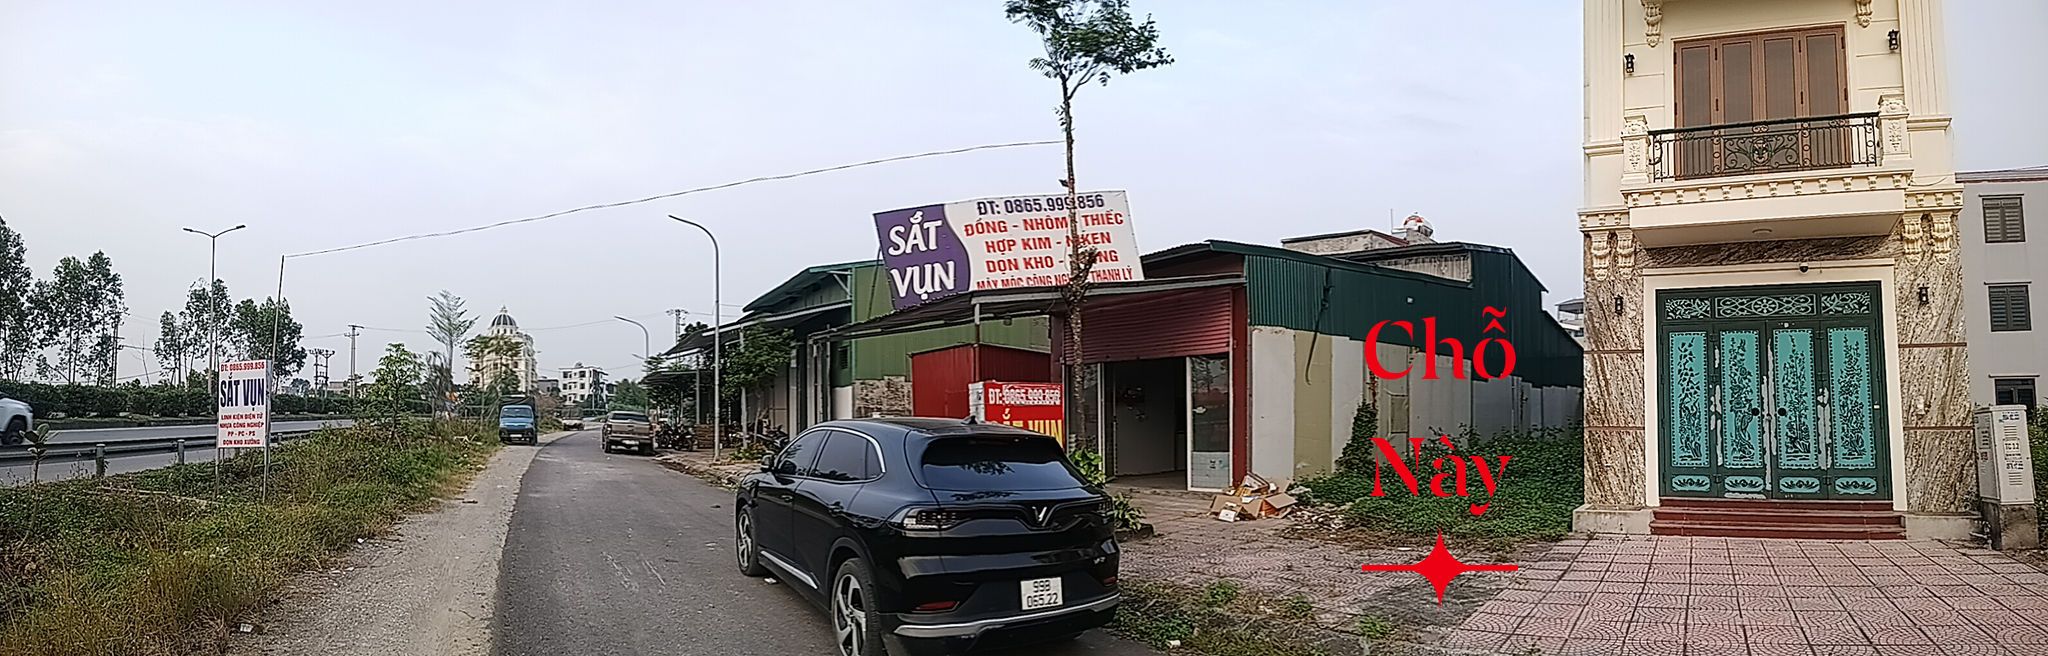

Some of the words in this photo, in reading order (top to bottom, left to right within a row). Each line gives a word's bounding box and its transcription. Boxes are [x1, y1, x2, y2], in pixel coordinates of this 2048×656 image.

[976, 200, 1001, 215] ĐT:
[888, 210, 943, 256] SẮT
[963, 217, 1009, 237] ĐỒNG
[1022, 214, 1069, 232] NHÔM
[1081, 209, 1124, 227] THIẾC
[985, 239, 1017, 255] HỢP
[1022, 237, 1052, 251] KIM
[985, 258, 1019, 275] DỌN
[1022, 255, 1054, 270] KHO
[1090, 268, 1121, 282] THANH
[1122, 265, 1133, 280] LÝ
[890, 260, 955, 300] VỤN
[220, 371, 240, 407] SẮT
[243, 378, 265, 411] VỤN
